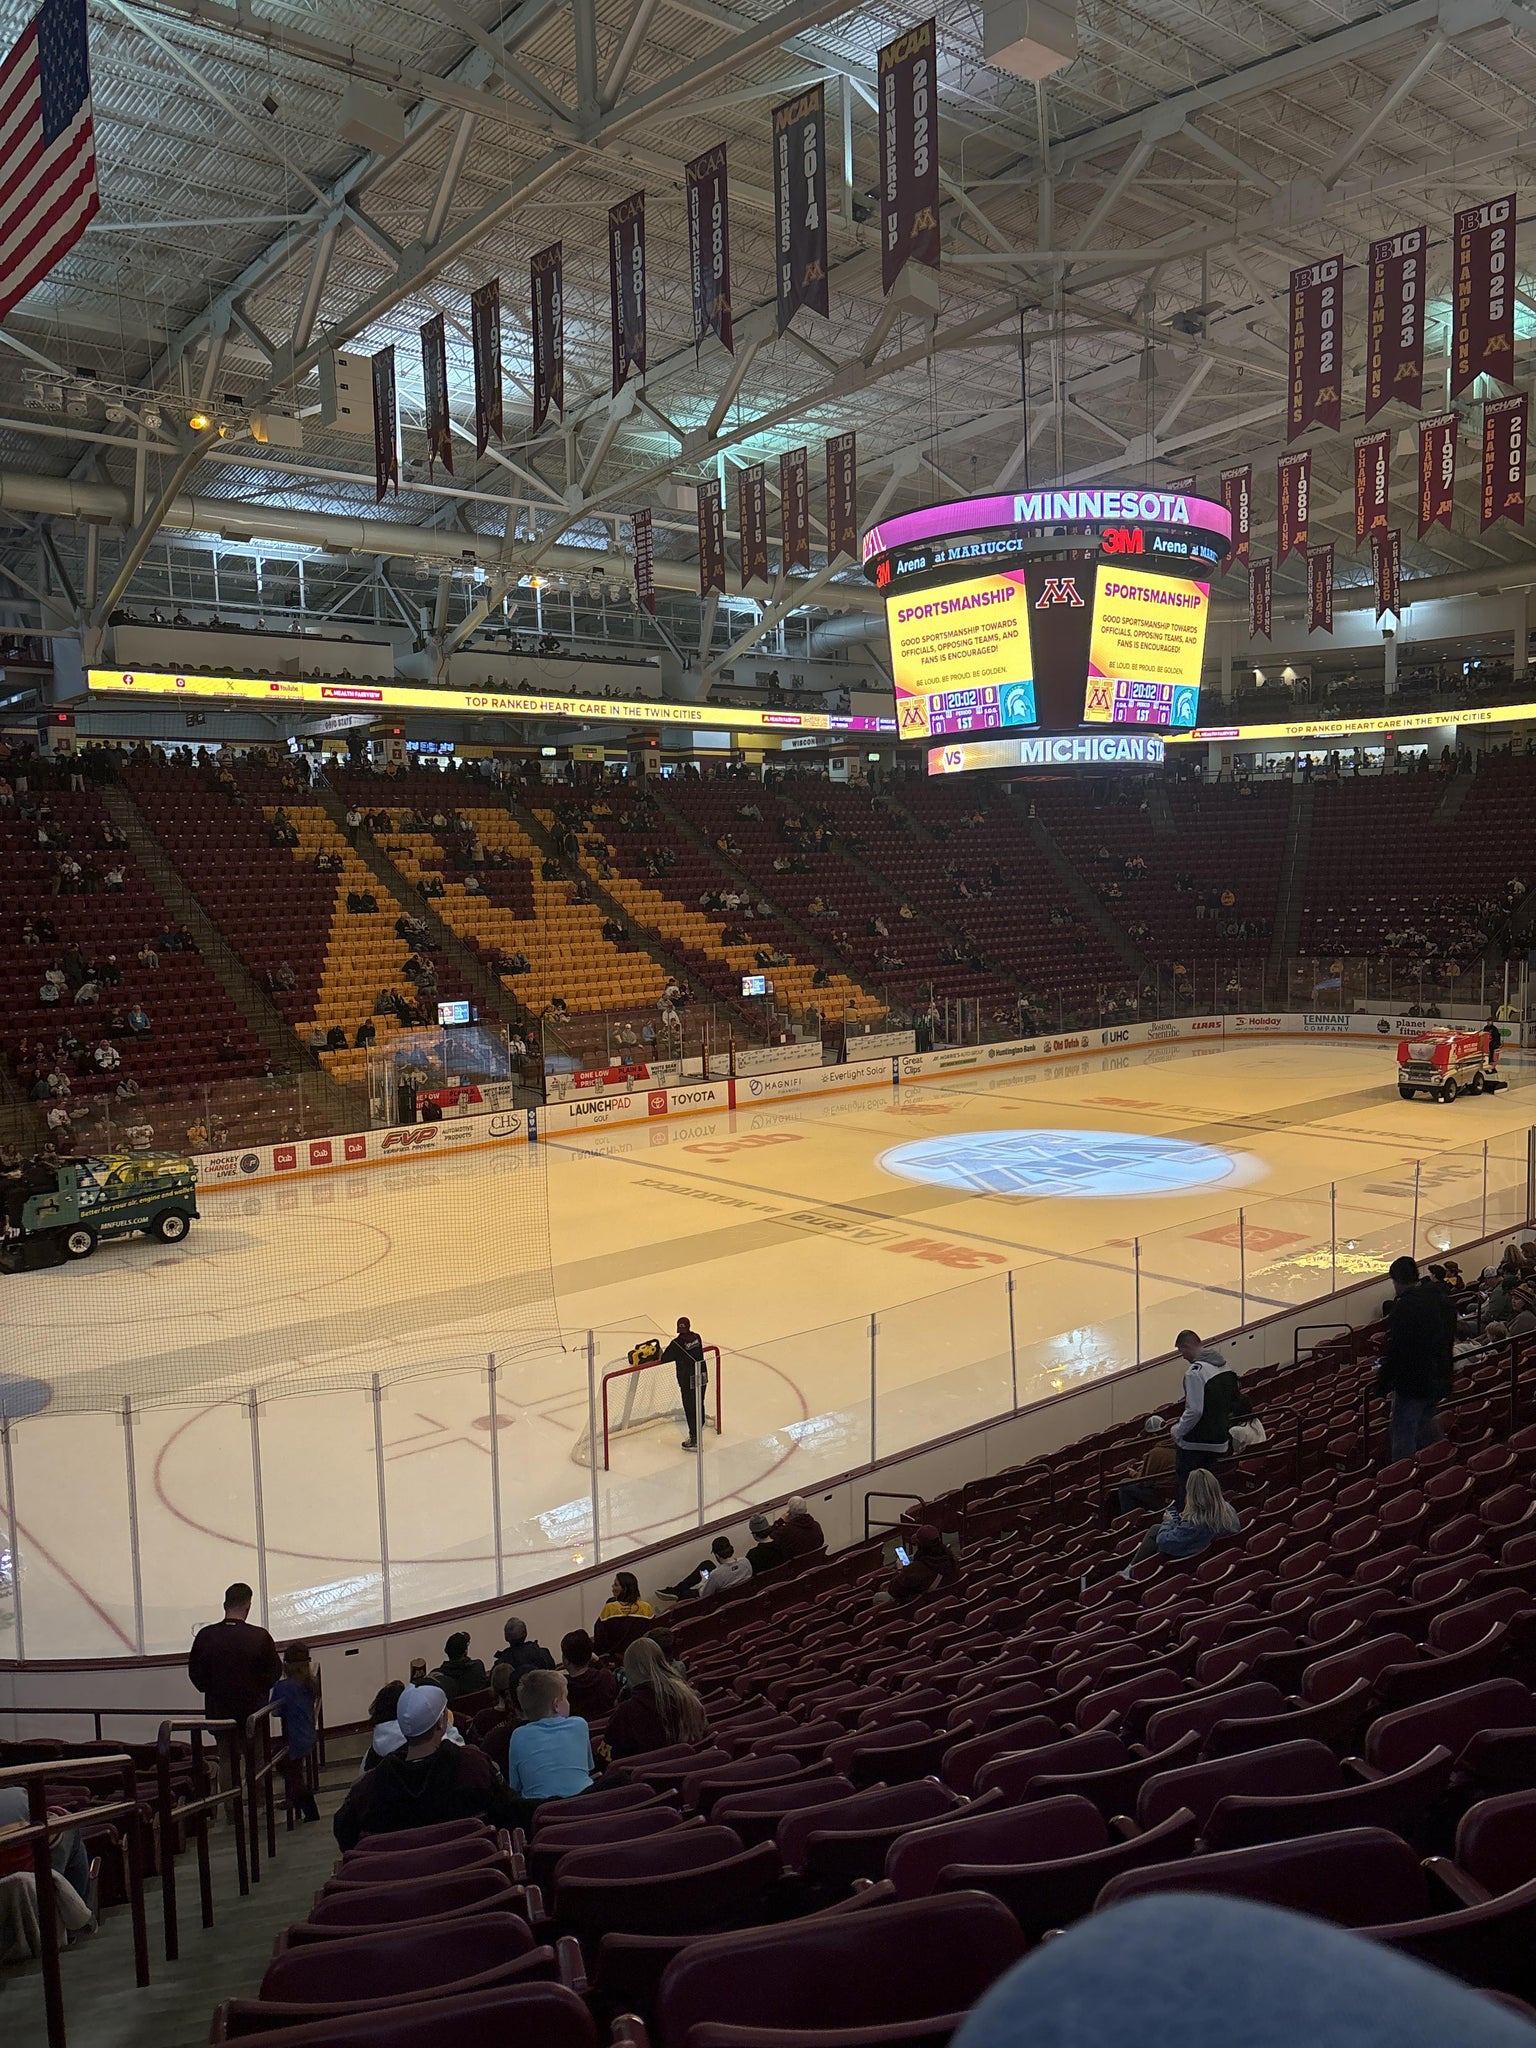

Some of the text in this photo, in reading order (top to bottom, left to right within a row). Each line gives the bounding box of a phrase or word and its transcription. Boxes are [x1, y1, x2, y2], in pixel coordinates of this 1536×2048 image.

[880, 25, 931, 73] NCAA
[775, 90, 821, 133] NCAA
[912, 58, 929, 177] 2023
[686, 150, 726, 184] NCAA
[885, 74, 899, 250] RUNNERS UP
[803, 123, 819, 231] 2014
[609, 197, 644, 227] NCAA
[779, 134, 791, 298] RUNNERS UP
[711, 177, 724, 280] 1989
[532, 249, 562, 273] NCAA
[631, 222, 643, 317] 1981
[691, 186, 702, 340] RUNNERS UP
[1489, 228, 1506, 321] 2025
[614, 230, 626, 374] RUNNERS UP
[1400, 259, 1417, 348] 2023
[1458, 234, 1471, 374] CHAMPIONS
[551, 271, 562, 360] 1975
[1319, 286, 1335, 374] 2022
[1371, 264, 1385, 399] CHAMPIONS
[535, 277, 546, 411] RUNNERS UP
[1294, 292, 1305, 423] CHAMPIONS
[1442, 428, 1453, 490] 1997
[1508, 416, 1522, 482] 2006
[1375, 446, 1385, 505] 1992
[1423, 431, 1433, 521] CHAMPIONS
[1484, 418, 1495, 518] CHAMPIONS
[843, 453, 852, 517] 2017
[1297, 466, 1307, 522] 1989
[1357, 448, 1366, 535] CHAMPIONS
[796, 467, 804, 529] 2016
[1014, 491, 1190, 524] MINNESOTA
[1239, 479, 1249, 533] 1988
[753, 484, 762, 543] 2015
[711, 498, 720, 555] 2014
[1101, 528, 1146, 555] 3M
[1153, 536, 1188, 554] Arena
[876, 539, 1024, 588] 3M Arena at MARIUCCI
[898, 586, 1016, 623] SPORTSMANSHIP
[1104, 582, 1201, 609] SPORTSMANSHIP
[900, 619, 1018, 647] GOOD SPORTSMANSHIP TOWARDS
[1102, 614, 1198, 634] GOOD SPORTSMANSHIP TOWARDS
[901, 630, 1019, 658] OFFICIALS, OPPOSING TEAMS, AND
[1100, 626, 1197, 645] OFFICIALS, OPPOSING TEAMS, AND
[1117, 639, 1181, 654] FANS IS ENCOURAGED!
[921, 655, 939, 665] FANS
[947, 645, 999, 660] ENCOURAGED!
[279, 684, 299, 692] YouTube
[916, 679, 924, 687] BE
[941, 675, 950, 683] BE
[972, 670, 981, 678] BE
[1119, 681, 1127, 698] 0
[333, 689, 381, 699] HEALTH FAIRVIEW
[948, 690, 977, 708] 20:02
[985, 687, 994, 704] 0
[1132, 683, 1157, 700] 20:02
[1162, 685, 1170, 701] 0
[465, 696, 703, 720] TOP RANKED HEART CARE IN THE TWIN CITIES
[932, 695, 941, 711] 0
[957, 716, 973, 730] 1ST
[1136, 709, 1150, 721] 1ST
[1305, 724, 1343, 733] RANKED
[1345, 722, 1375, 731] HEART
[1377, 720, 1401, 729] CARE
[1416, 717, 1432, 725] THE
[1435, 714, 1460, 723] TWIN
[1462, 712, 1492, 721] CITIES
[945, 751, 962, 766] VS
[1021, 738, 1144, 764] MICHIGAN
[1151, 1023, 1172, 1031] Boston
[1191, 1022, 1222, 1030] CLAAS
[1249, 1017, 1282, 1026] Holiday
[1302, 1014, 1351, 1025] TENNANT
[1396, 1019, 1426, 1029] planet
[1053, 1037, 1080, 1051] Old Dutch
[1109, 1030, 1129, 1043] UHC
[1147, 1028, 1180, 1040] Scientific
[903, 1056, 923, 1066] Great
[995, 1044, 1036, 1058] Huntington Bank
[580, 1071, 594, 1079] ONE
[595, 1070, 610, 1078] LOW
[829, 1066, 887, 1082] Everlight Solar
[904, 1065, 922, 1076] Clips
[765, 1079, 802, 1090] MAGNIFI
[570, 1097, 632, 1117] LAUNCHPAD
[671, 1090, 716, 1106] TOYOTA
[491, 1114, 519, 1130] CHS
[593, 1114, 609, 1123] GOLF
[381, 1126, 438, 1149] FVP
[441, 1125, 474, 1135] AUTOMOTIVE
[444, 1132, 472, 1141] PRODUCTS
[313, 1150, 328, 1158] Cub
[348, 1145, 363, 1153] Cub
[682, 1133, 804, 1155] Cub
[204, 1163, 238, 1173] CHANGES
[210, 1155, 240, 1166] HOCKEY
[277, 1155, 293, 1163] Cub
[217, 1170, 238, 1178] LIVES.
[80, 1209, 101, 1218] Better
[110, 1202, 128, 1212] your
[139, 1195, 160, 1204] engine
[161, 1191, 174, 1199] and
[100, 1216, 149, 1230] MNFUELS.COM
[790, 1214, 889, 1239] Arena
